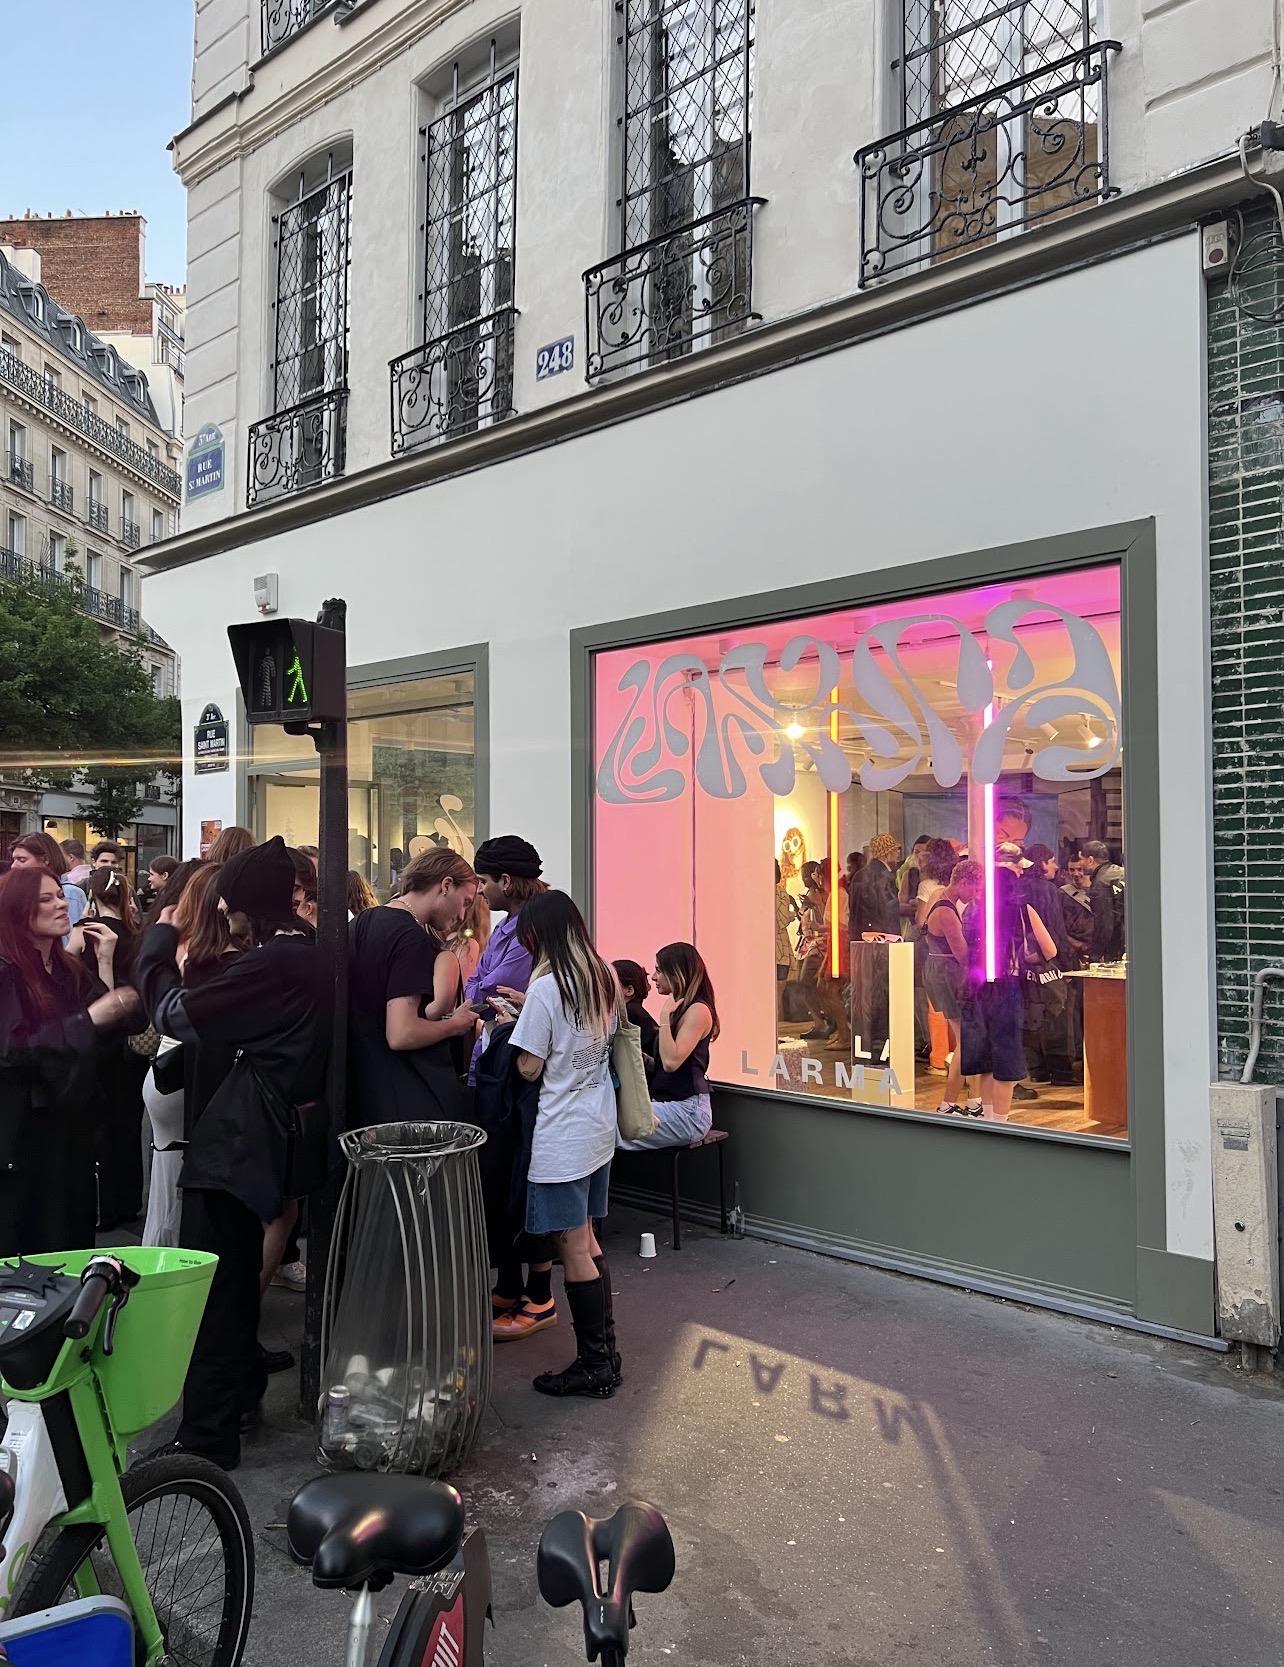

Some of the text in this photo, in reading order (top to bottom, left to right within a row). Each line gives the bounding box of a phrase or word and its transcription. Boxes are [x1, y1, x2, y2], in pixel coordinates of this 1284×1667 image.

[537, 341, 573, 378] 248
[198, 459, 212, 473] RUE
[196, 470, 220, 488] MARTIN
[207, 730, 215, 739] RUE
[198, 738, 225, 750] SAINT MARTIN
[741, 1050, 903, 1096] LARMA
